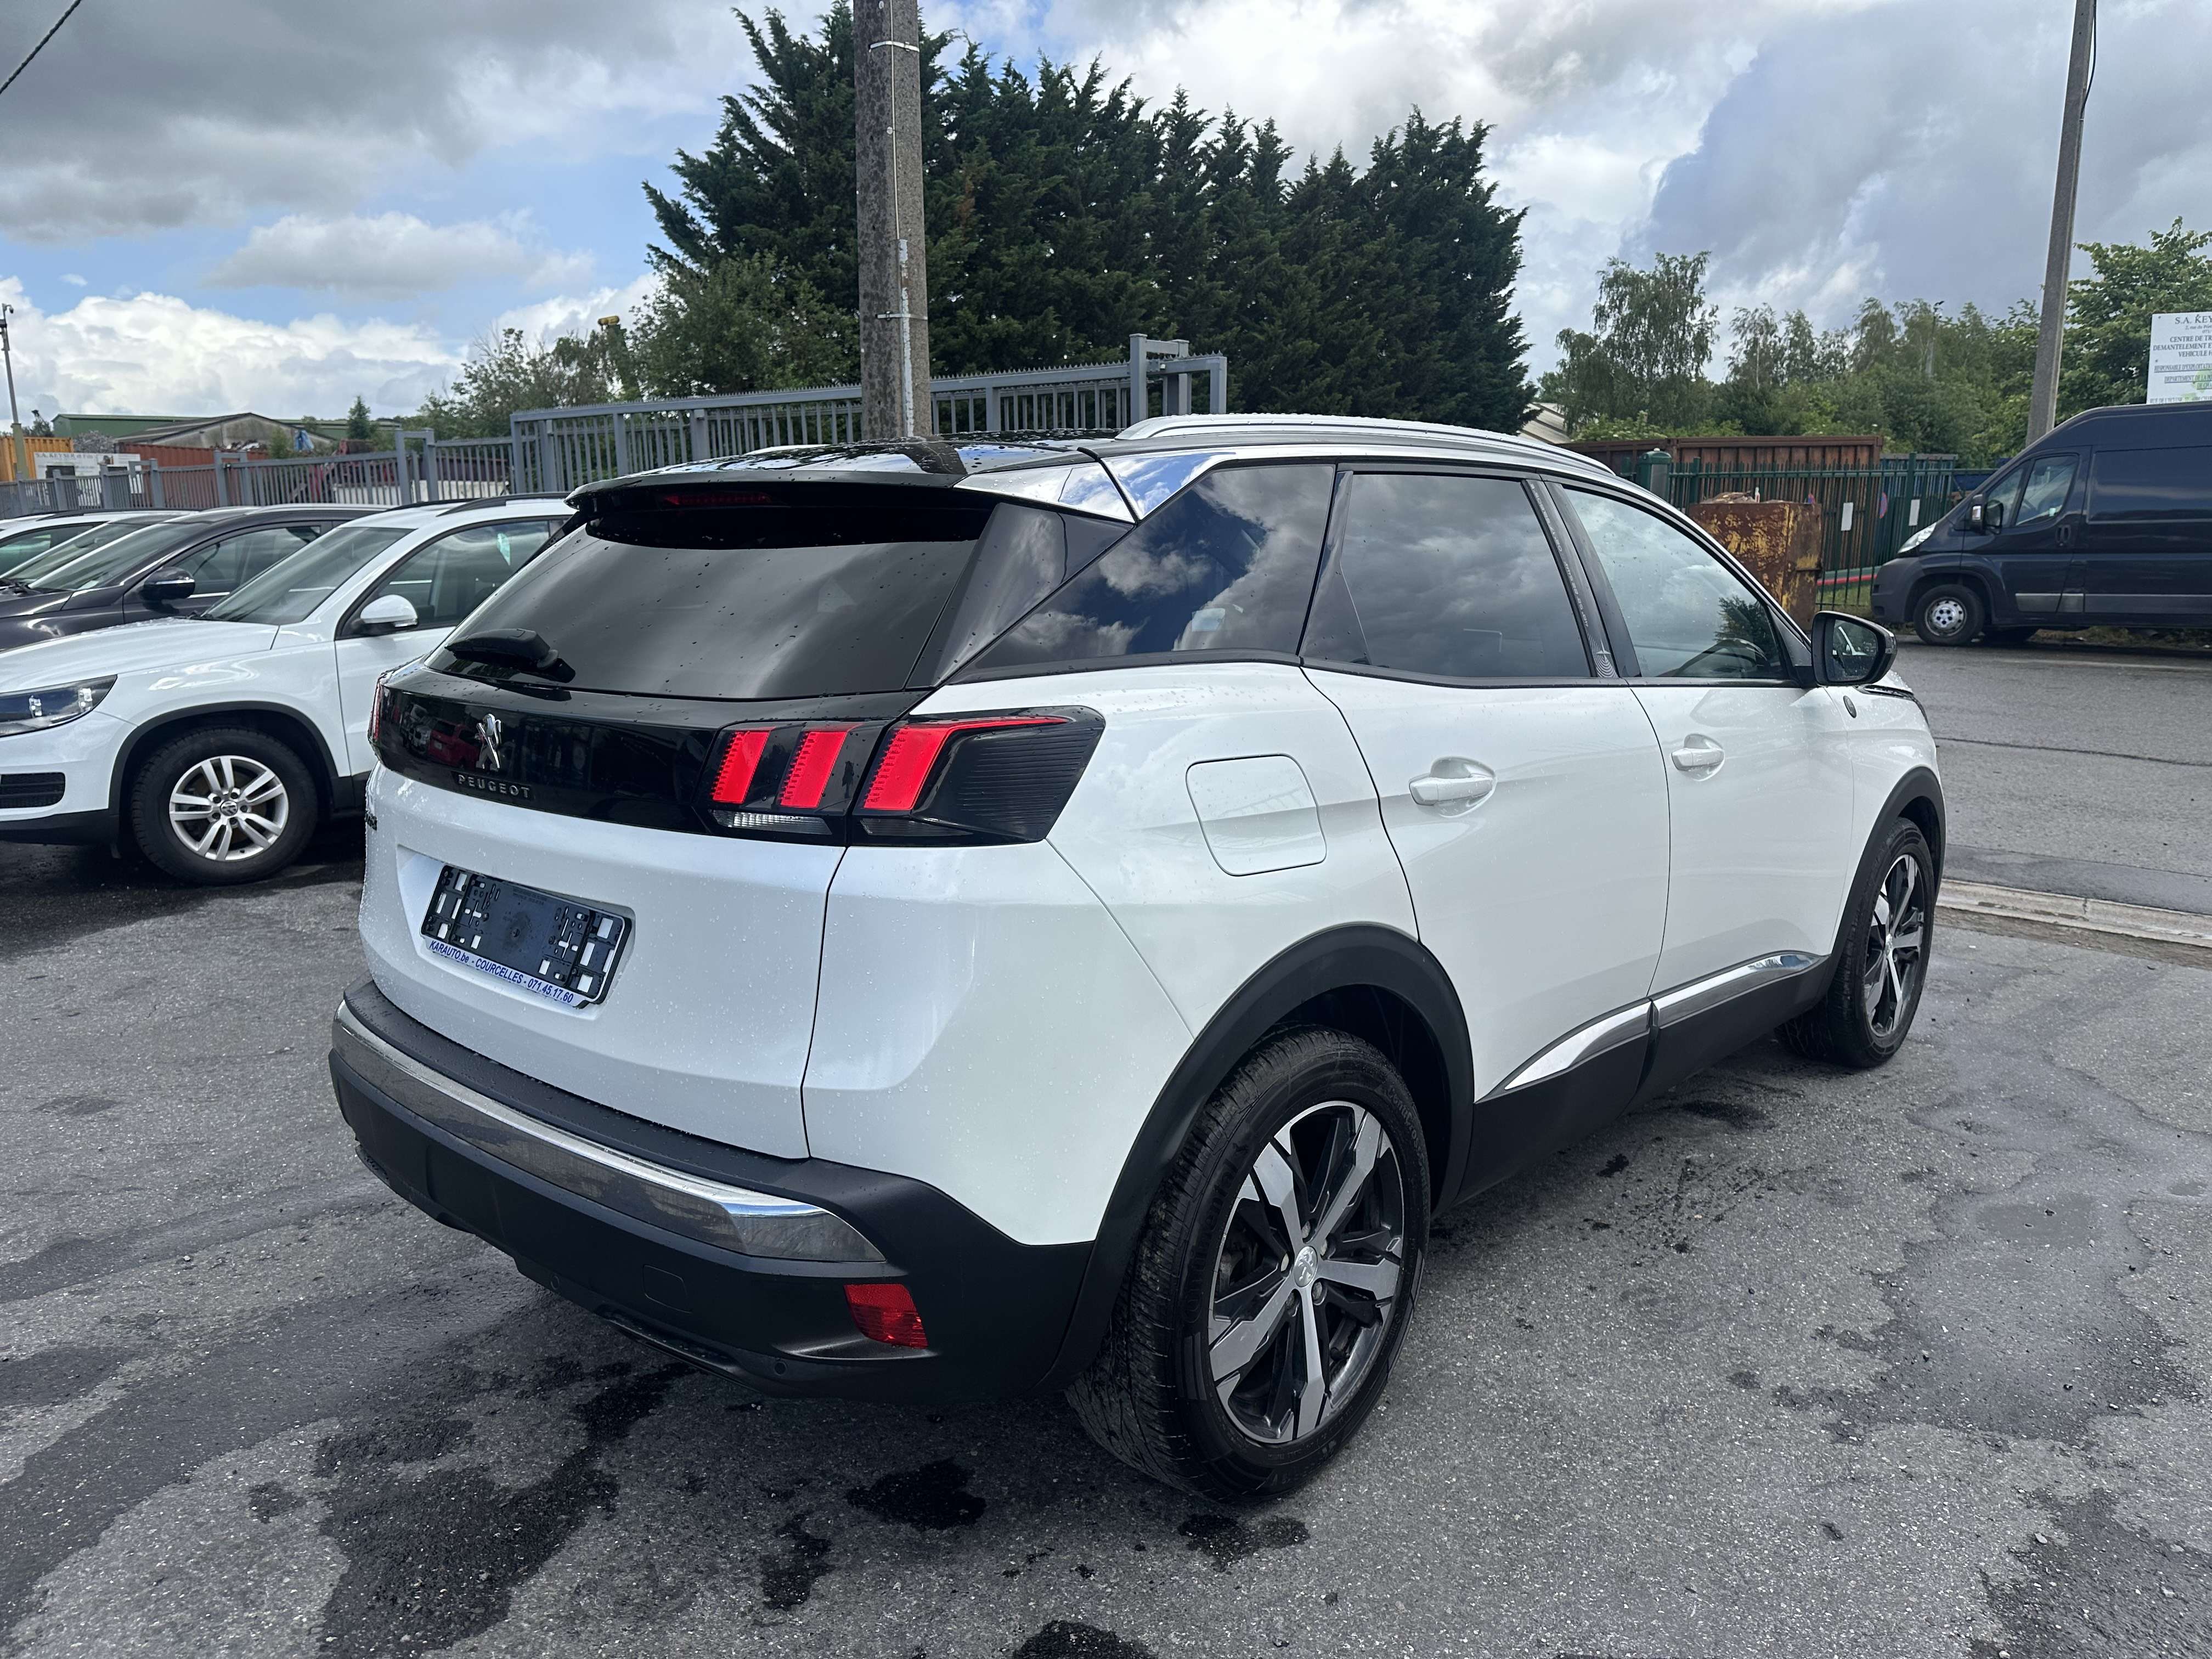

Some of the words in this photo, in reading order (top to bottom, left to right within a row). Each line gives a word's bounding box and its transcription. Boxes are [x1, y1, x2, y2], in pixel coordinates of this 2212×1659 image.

[458, 774, 530, 798] PEUGEOT
[429, 940, 469, 963] KARAUTO.be
[475, 958, 523, 984] COURCELLES
[527, 978, 574, 1003] 071.45.17.60
